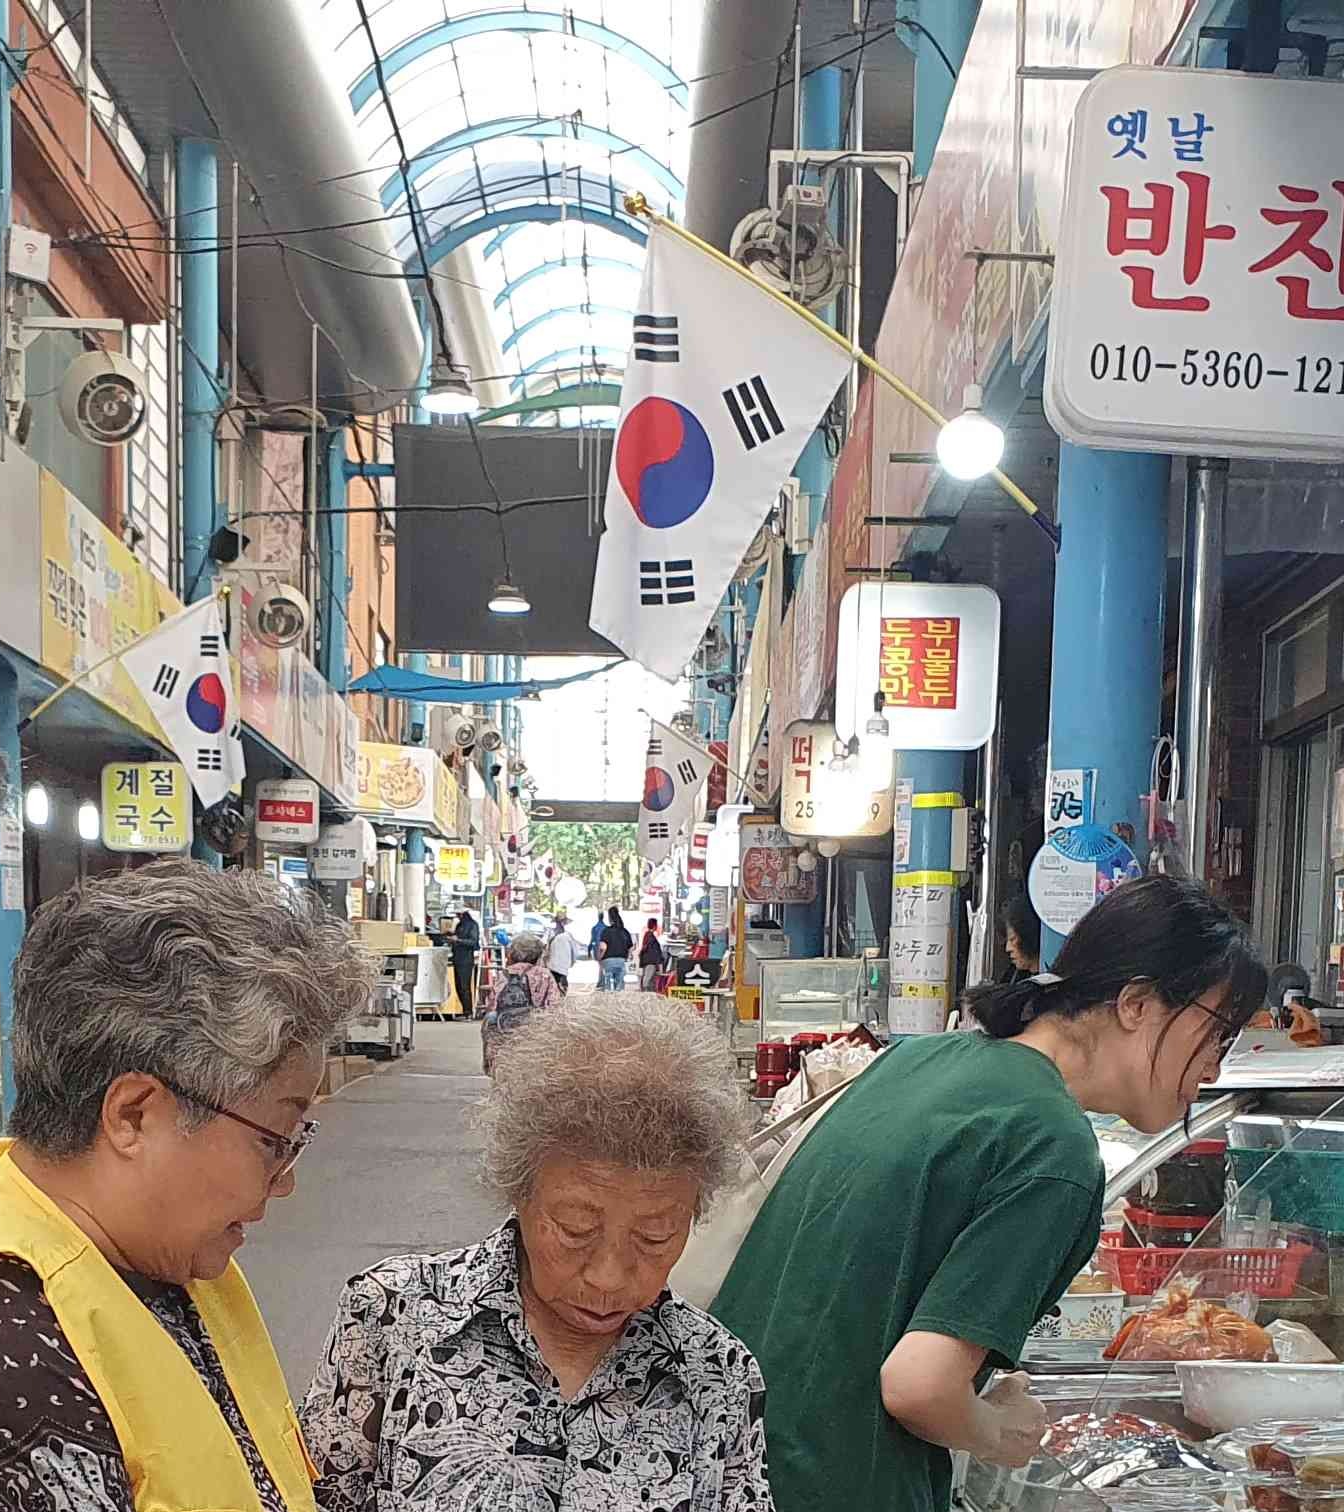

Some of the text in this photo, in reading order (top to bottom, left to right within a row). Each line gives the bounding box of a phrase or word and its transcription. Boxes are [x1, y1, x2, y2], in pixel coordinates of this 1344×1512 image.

[1106, 109, 1215, 162] 옛날
[881, 619, 956, 647] 두부
[879, 677, 954, 705] 만두
[115, 768, 174, 796] 계절
[115, 804, 175, 832] 국수
